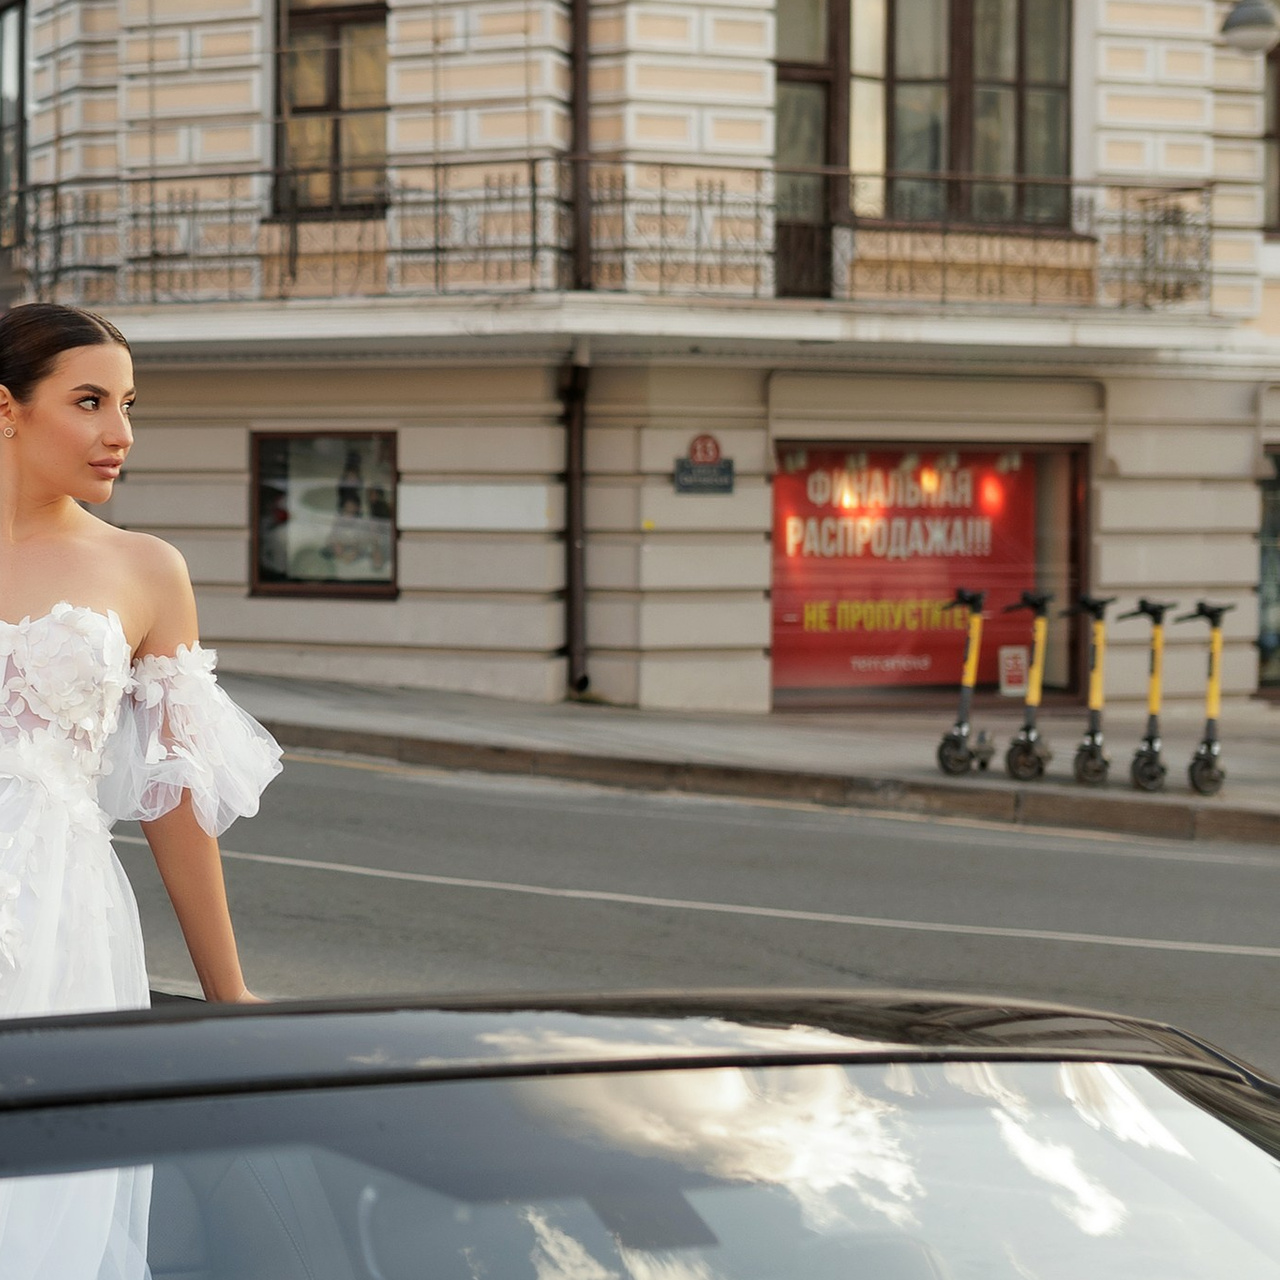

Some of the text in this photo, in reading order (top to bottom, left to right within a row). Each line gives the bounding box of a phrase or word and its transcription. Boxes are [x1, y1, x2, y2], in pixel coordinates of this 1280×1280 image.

[806, 468, 972, 508] ФИНАЛЬНАЯ
[786, 516, 992, 561] РАСПРОДАЖА!!!
[804, 600, 831, 632] НЕ
